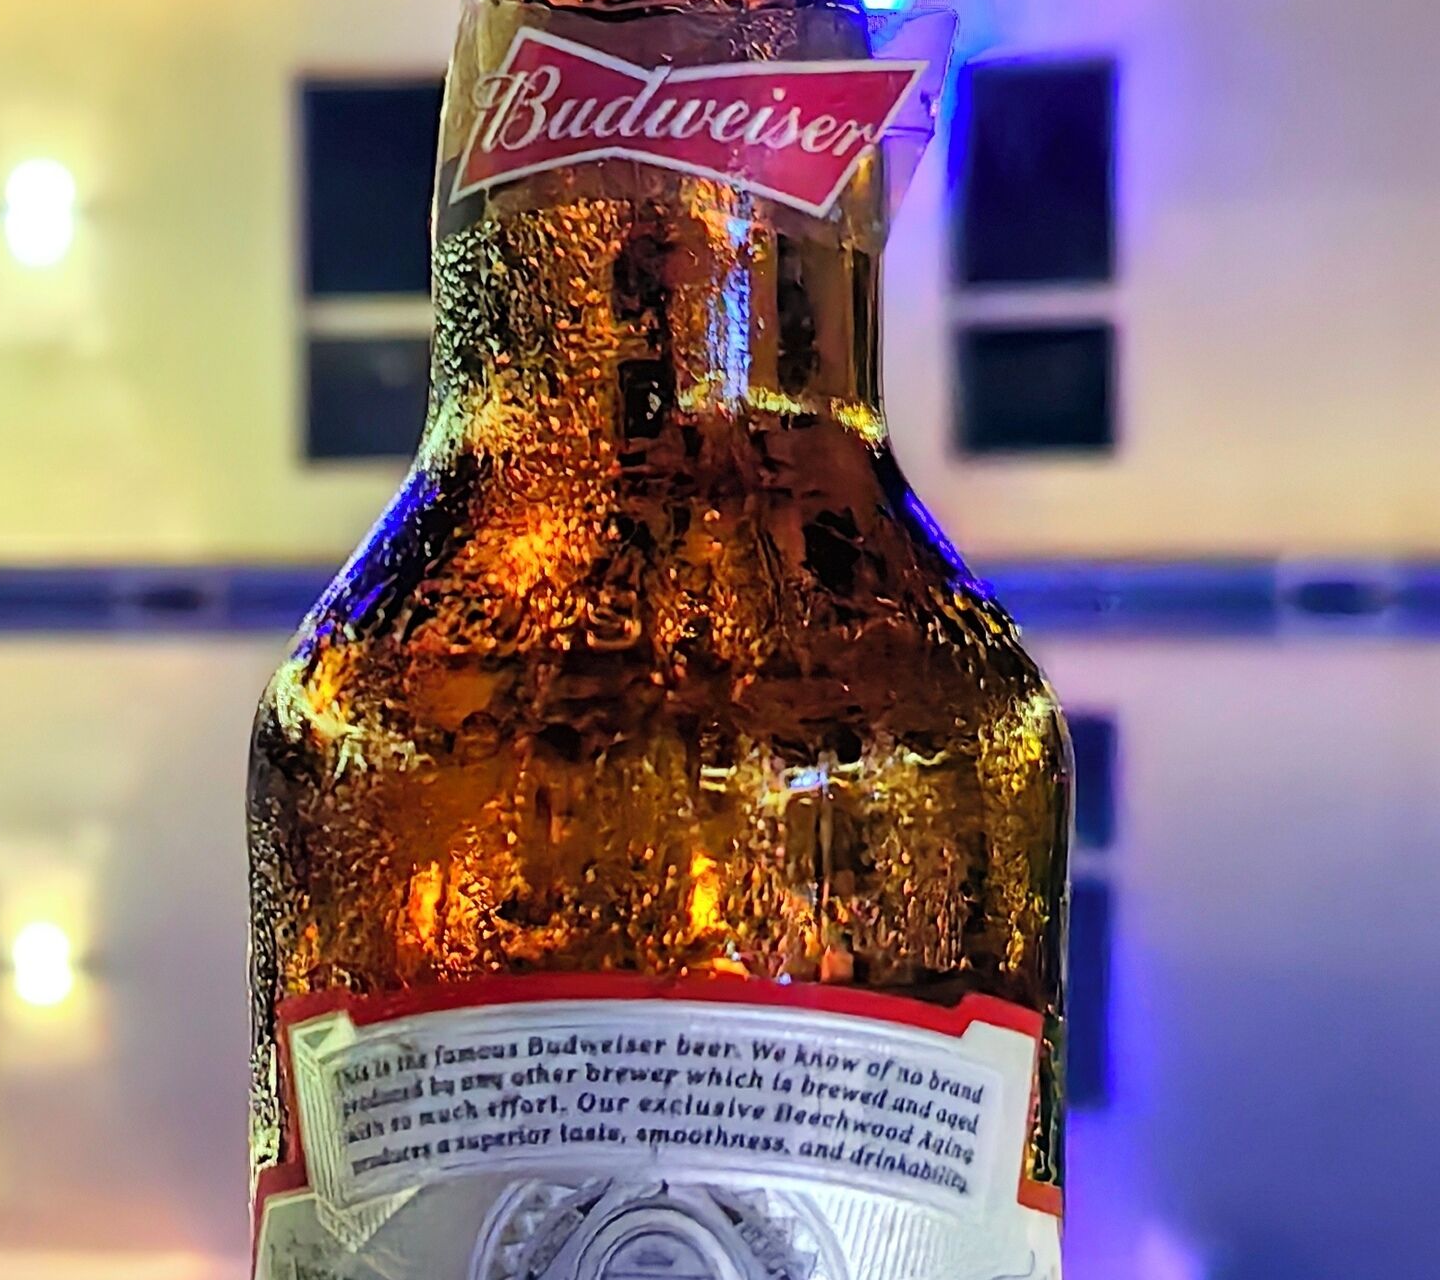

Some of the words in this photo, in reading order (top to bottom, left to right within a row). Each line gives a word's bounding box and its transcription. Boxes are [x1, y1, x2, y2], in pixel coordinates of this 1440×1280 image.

[473, 64, 891, 157] Budweiser
[435, 1044, 518, 1066] famous
[528, 1033, 667, 1056] Budweiser
[751, 1039, 786, 1063] We
[794, 1043, 859, 1071] know
[866, 1056, 894, 1081] of
[897, 1068, 923, 1086] no
[929, 1069, 985, 1105] brand
[511, 1062, 578, 1087] other
[585, 1062, 678, 1088] brewer
[686, 1066, 762, 1089] which
[772, 1072, 792, 1094] is
[801, 1073, 888, 1110] brewed
[892, 1096, 934, 1120] and
[935, 1109, 980, 1136] aged
[419, 1099, 479, 1125] much
[577, 1091, 630, 1114] Our
[638, 1093, 765, 1121] exclusive
[773, 1102, 914, 1145] Beechwood
[917, 1129, 976, 1166] Aging
[436, 1138, 451, 1154] a
[454, 1127, 551, 1153] superior
[559, 1121, 627, 1145] taste,
[799, 1140, 846, 1161] and
